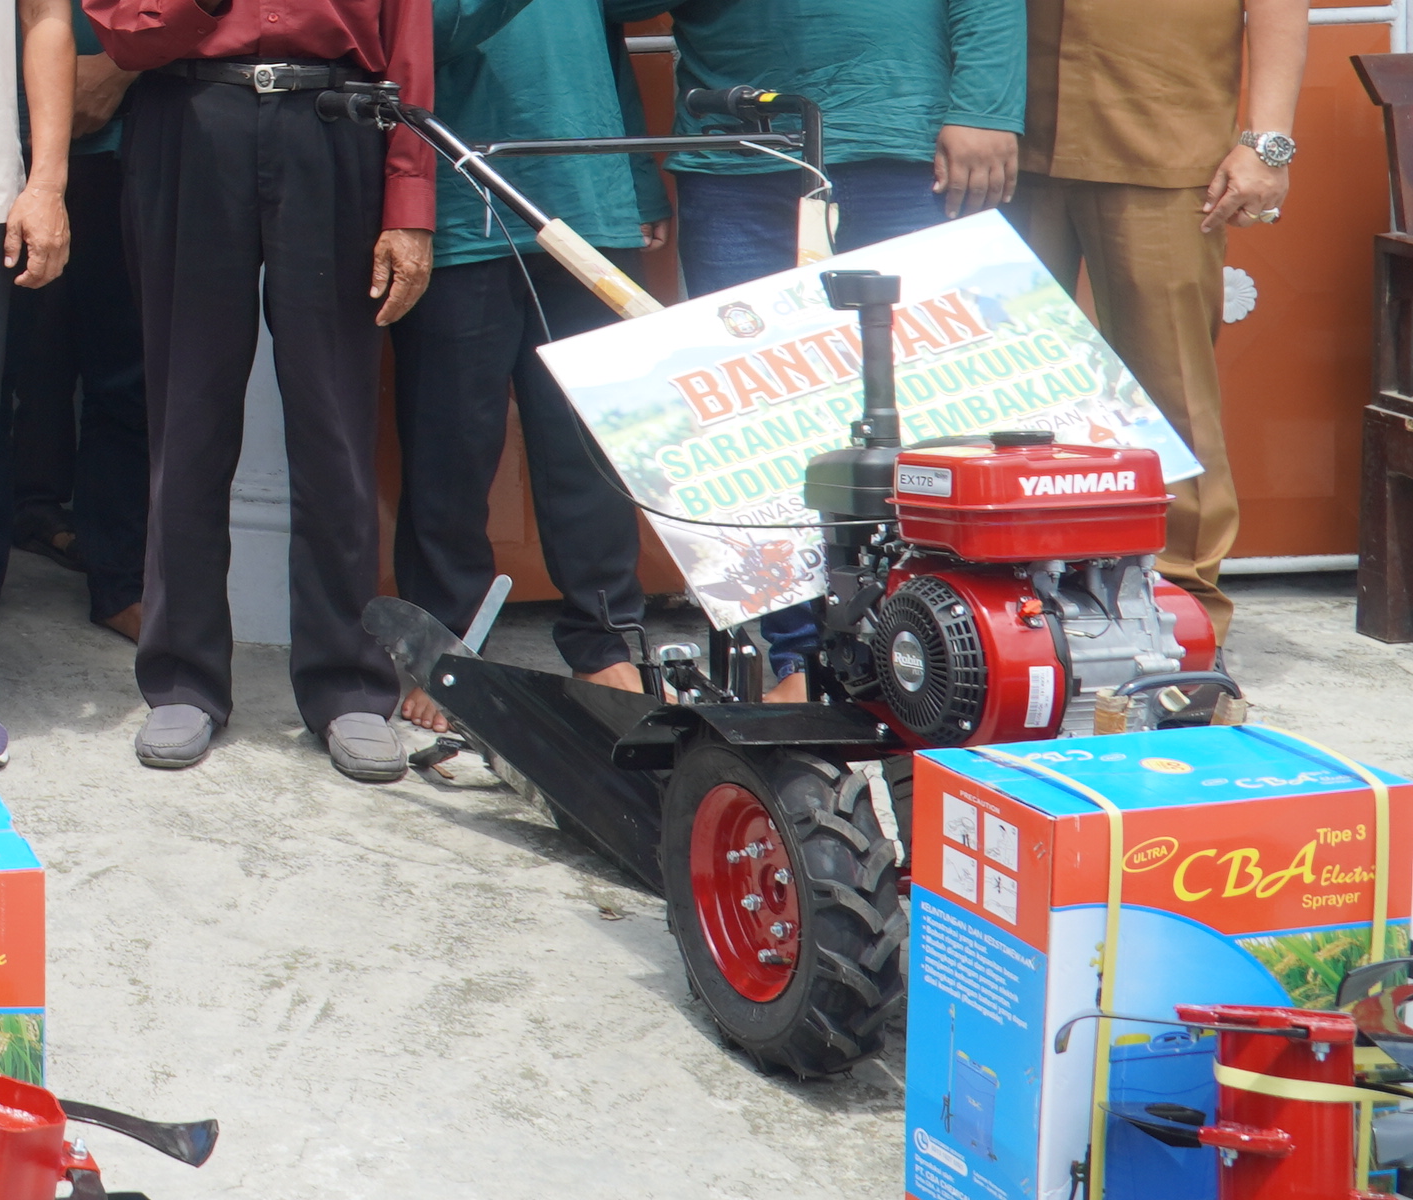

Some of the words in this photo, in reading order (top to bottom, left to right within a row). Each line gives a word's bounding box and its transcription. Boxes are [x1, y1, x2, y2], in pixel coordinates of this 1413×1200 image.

[671, 290, 993, 424] BANTAN
[902, 361, 1101, 440] EMBAKAU
[658, 407, 824, 484] SARANA
[735, 498, 805, 531] DINAS
[1035, 409, 1084, 432] DAN
[1018, 471, 1136, 496] YANMAR
[894, 651, 923, 669] Robin
[959, 790, 1001, 814] PRECAUTION
[1316, 826, 1352, 846] Tipe
[1355, 824, 1366, 841] 3
[1133, 844, 1168, 864] ULTRA
[1173, 839, 1317, 902] CBA
[1320, 863, 1376, 887] Electri
[1301, 890, 1362, 910] Sprayer
